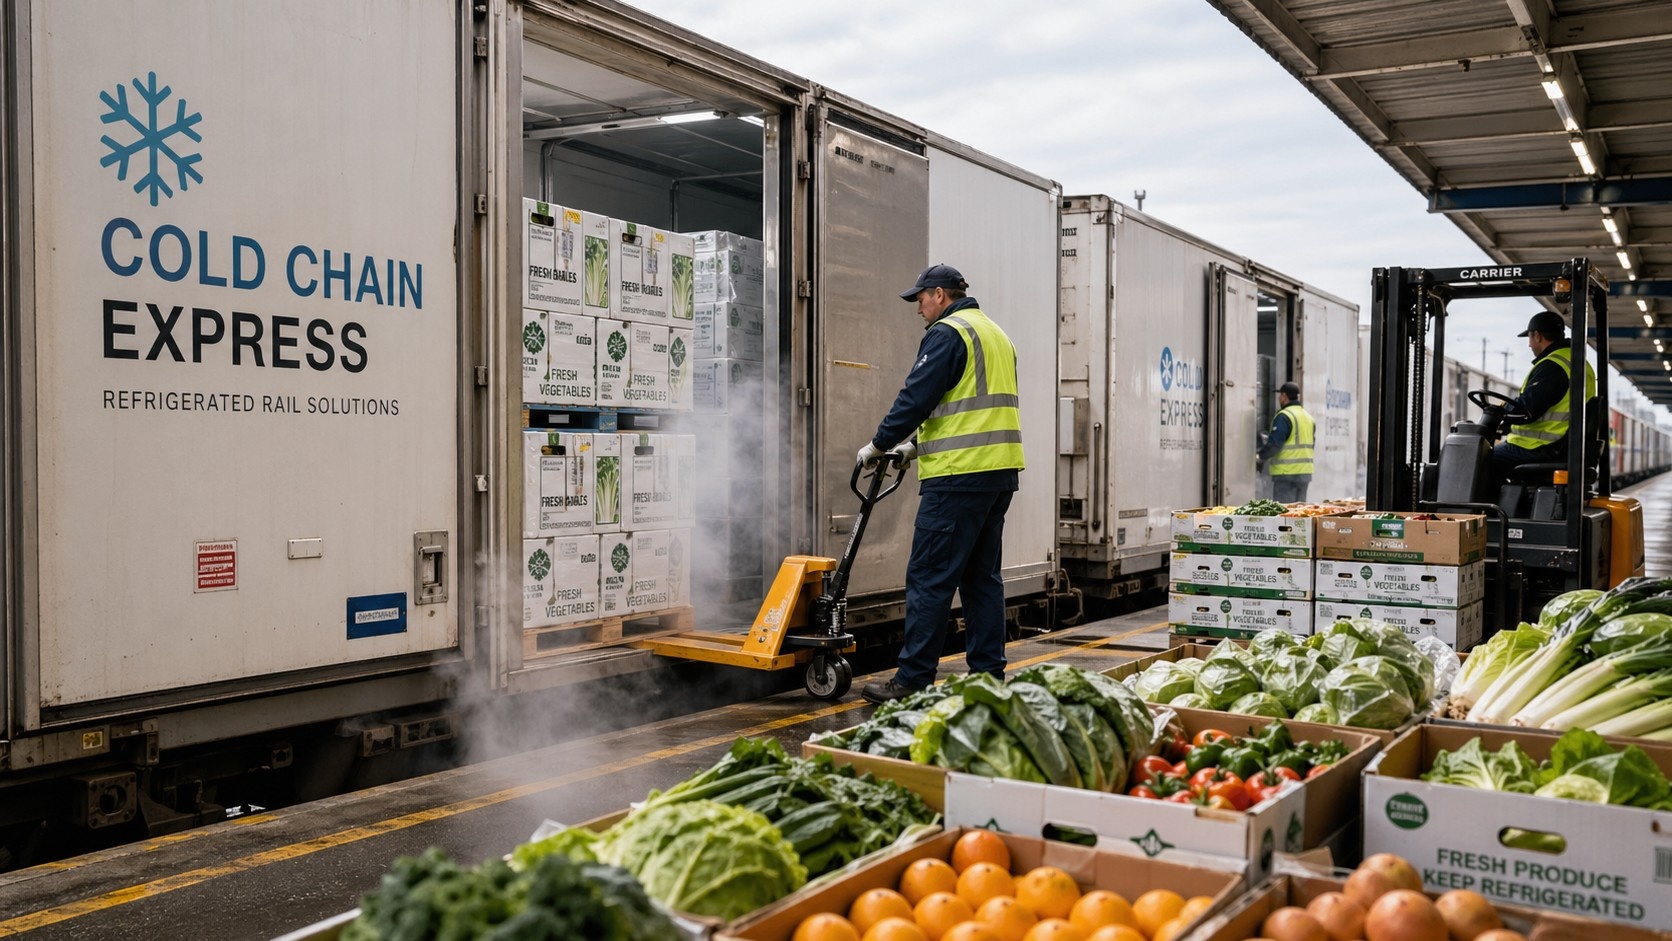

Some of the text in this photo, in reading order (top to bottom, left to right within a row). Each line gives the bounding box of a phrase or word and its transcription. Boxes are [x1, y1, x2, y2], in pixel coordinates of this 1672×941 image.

[101, 217, 422, 309] COLD CHAIN
[1460, 267, 1522, 279] CARRIER
[103, 299, 368, 373] EXPRESS
[552, 369, 577, 381] FRESH
[634, 374, 655, 386] FRESH
[539, 384, 591, 398] VEGETABLES
[103, 390, 399, 416] REFRIGERATED RAIL SOLUTIONS
[1161, 399, 1203, 428] EXPRESS
[557, 588, 582, 600] FRESH
[545, 602, 595, 618] VEGETABLES
[1437, 849, 1628, 894] FRESH PRODUCE
[1424, 869, 1645, 921] KEEP REFRIGERATED
